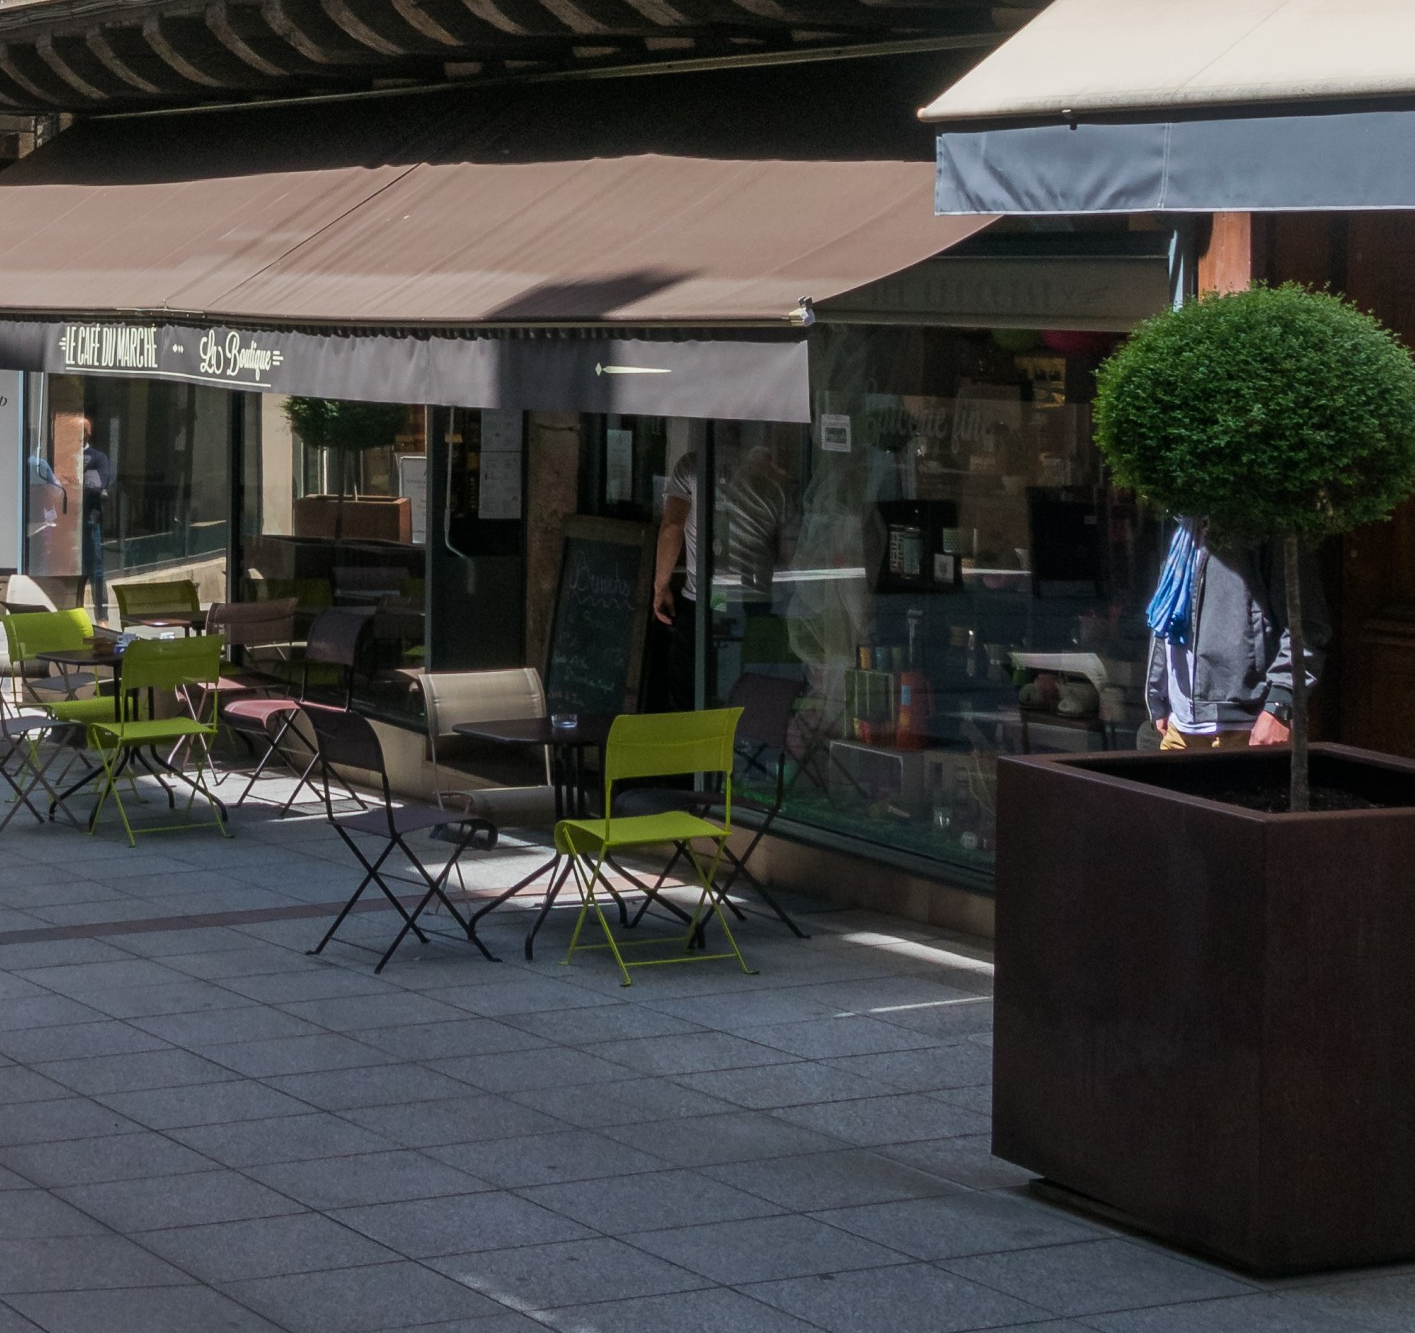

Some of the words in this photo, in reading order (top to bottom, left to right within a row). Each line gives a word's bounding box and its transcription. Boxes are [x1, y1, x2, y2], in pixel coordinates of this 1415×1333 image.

[65, 326, 76, 365] LE
[77, 323, 100, 366] CAFÉ
[101, 327, 116, 367] DU
[116, 323, 158, 369] MARCHÉ
[225, 331, 272, 382] Boutique
